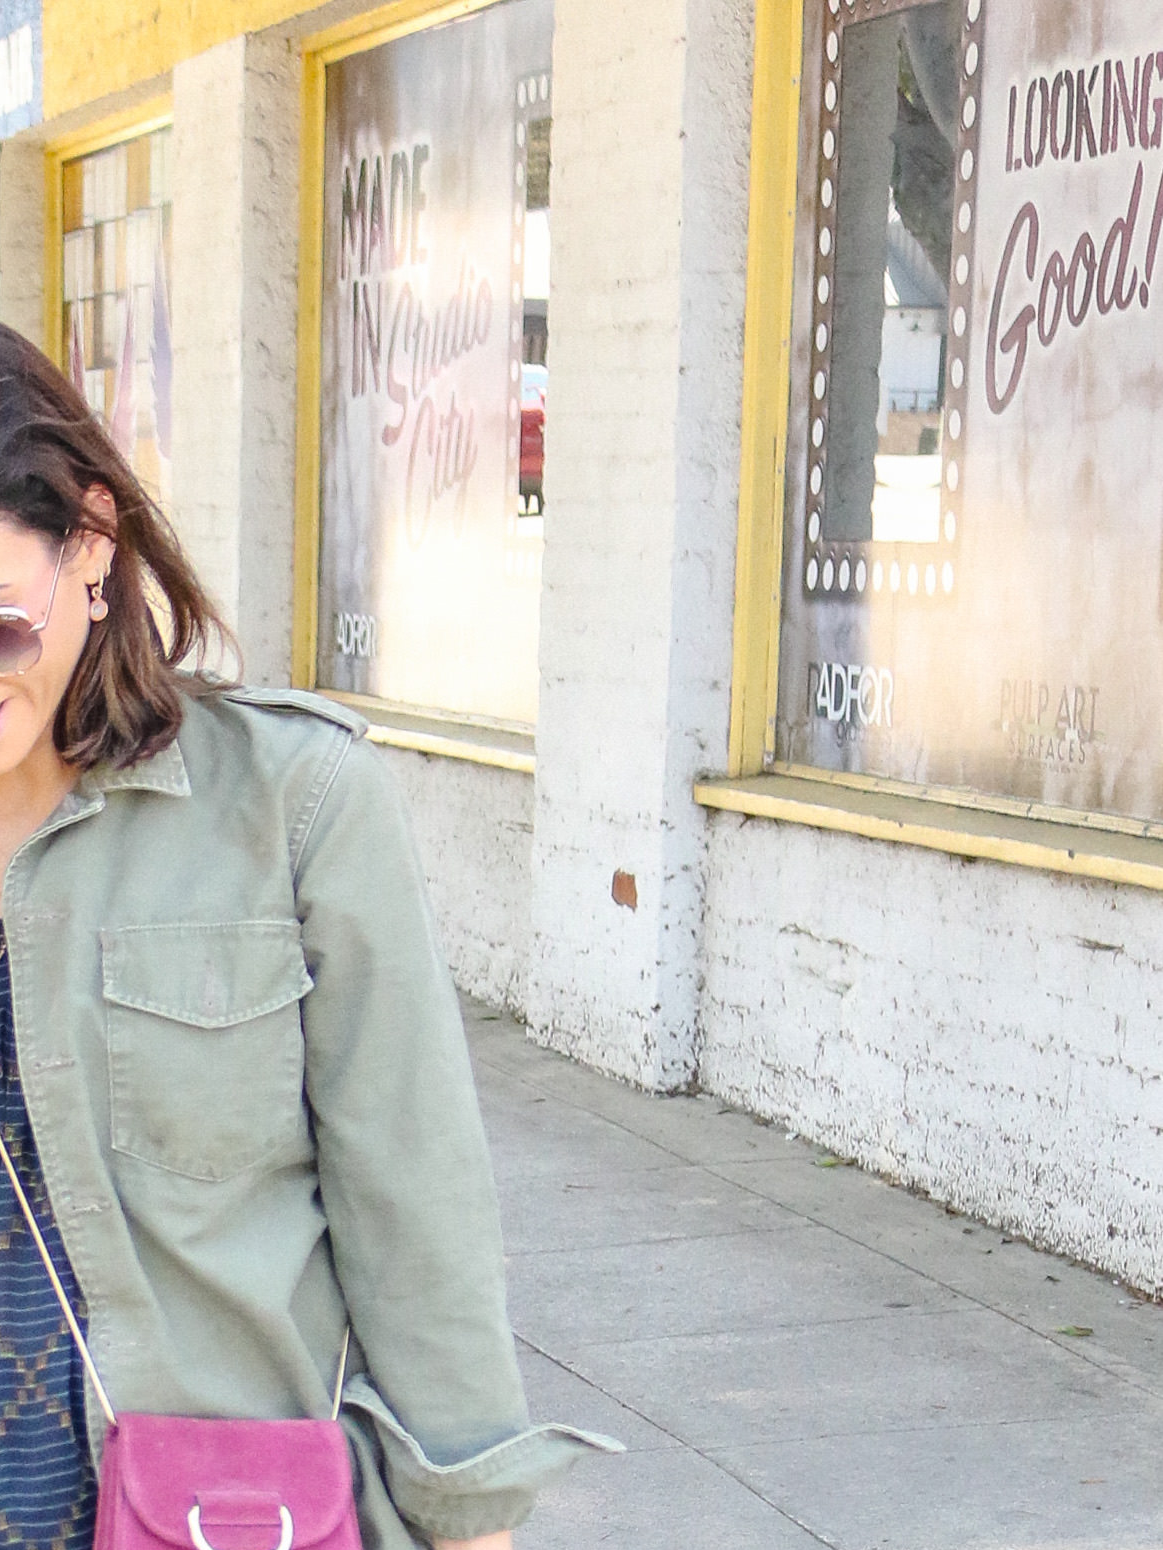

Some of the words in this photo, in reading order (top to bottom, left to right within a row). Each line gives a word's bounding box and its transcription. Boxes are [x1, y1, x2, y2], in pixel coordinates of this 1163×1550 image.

[1005, 51, 1163, 172] LOOKING
[340, 145, 429, 280] MADE
[351, 280, 382, 396] IN
[381, 262, 494, 446] Studio
[985, 160, 1163, 414] Good!
[405, 391, 478, 550] City
[1055, 684, 1099, 742] ART
